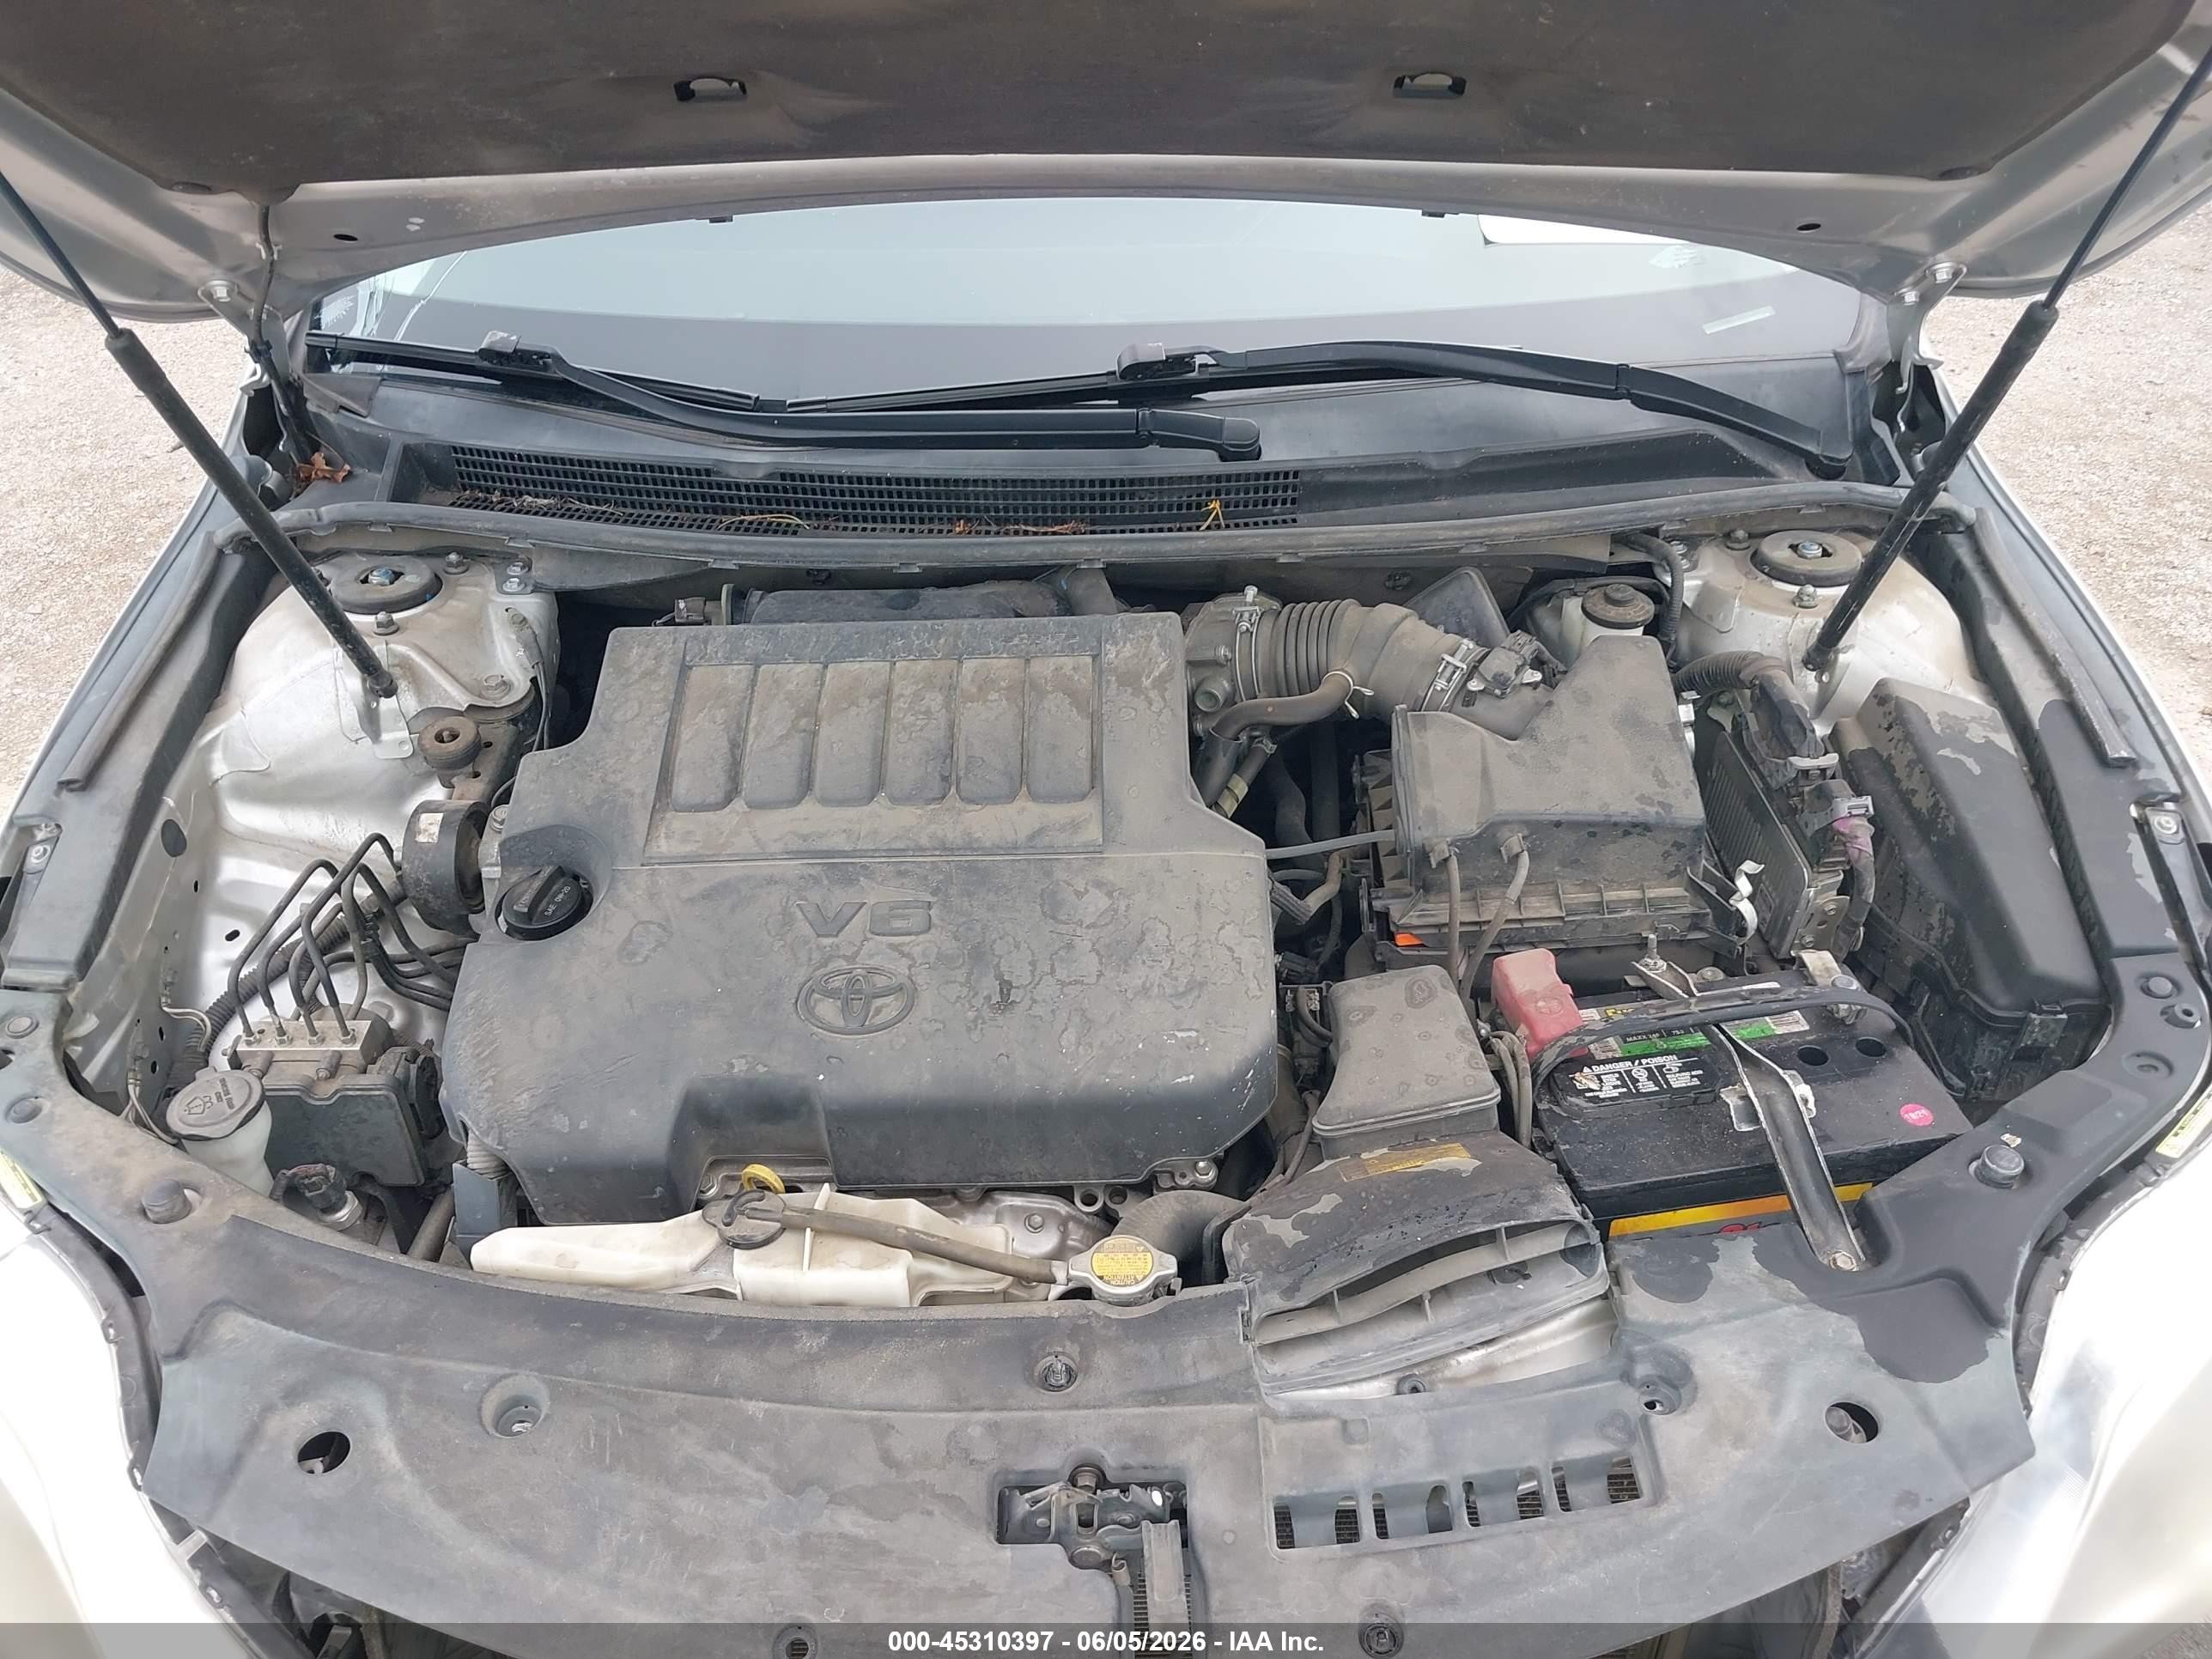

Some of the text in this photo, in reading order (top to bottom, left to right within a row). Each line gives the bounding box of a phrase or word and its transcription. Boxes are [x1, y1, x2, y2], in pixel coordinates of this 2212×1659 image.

[793, 900, 933, 938] V6
[1591, 1060, 1633, 1073] DANGER
[1640, 1054, 1679, 1065] POISON
